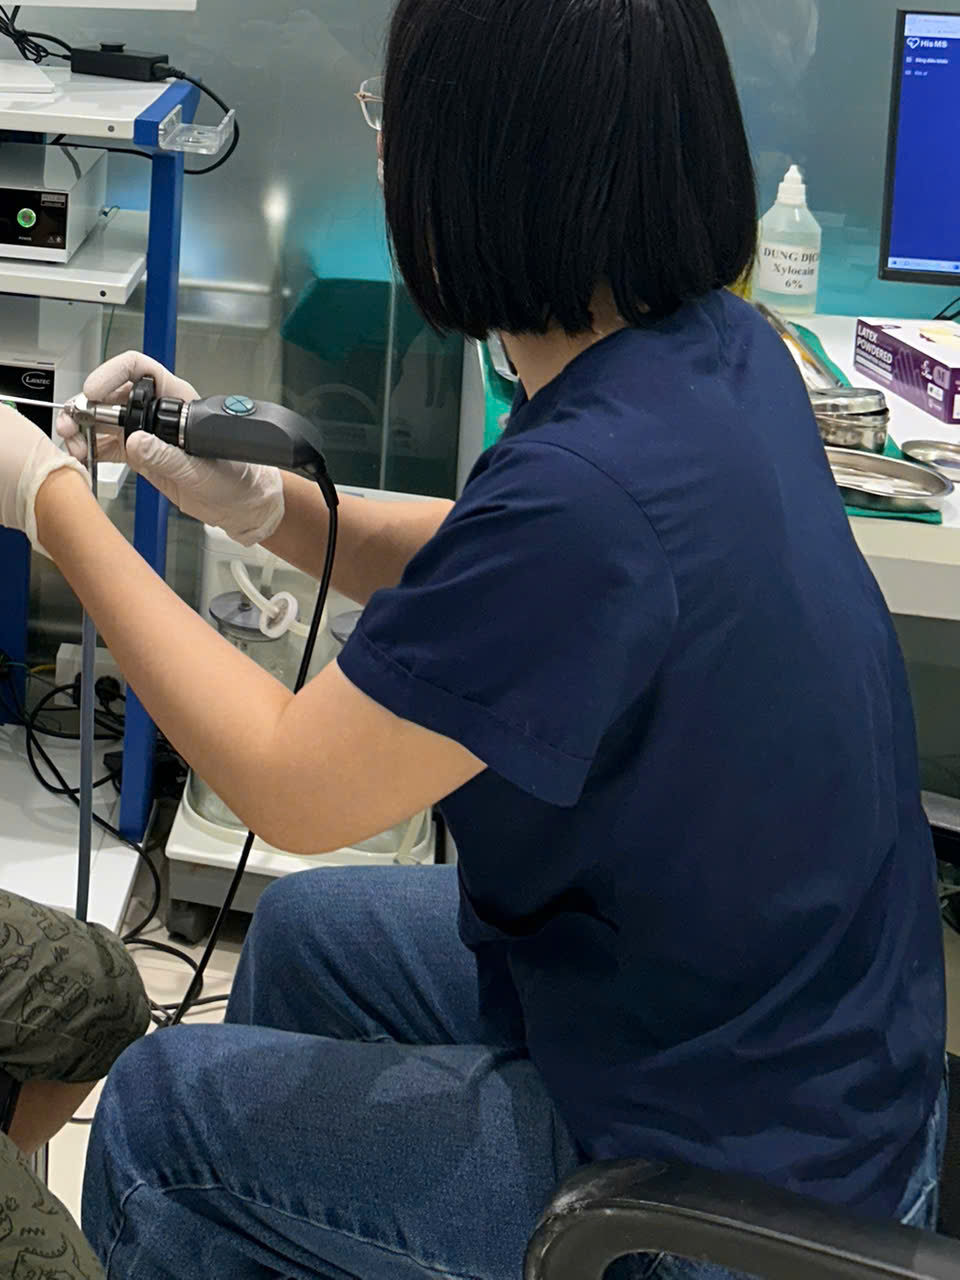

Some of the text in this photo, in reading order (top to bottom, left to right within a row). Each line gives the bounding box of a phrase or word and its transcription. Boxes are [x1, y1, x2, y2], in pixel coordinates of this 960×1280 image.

[764, 247, 819, 265] DUNG DỊC
[785, 279, 803, 289] 6%
[857, 324, 879, 344] LATEX
[856, 337, 893, 364] POWDERED
